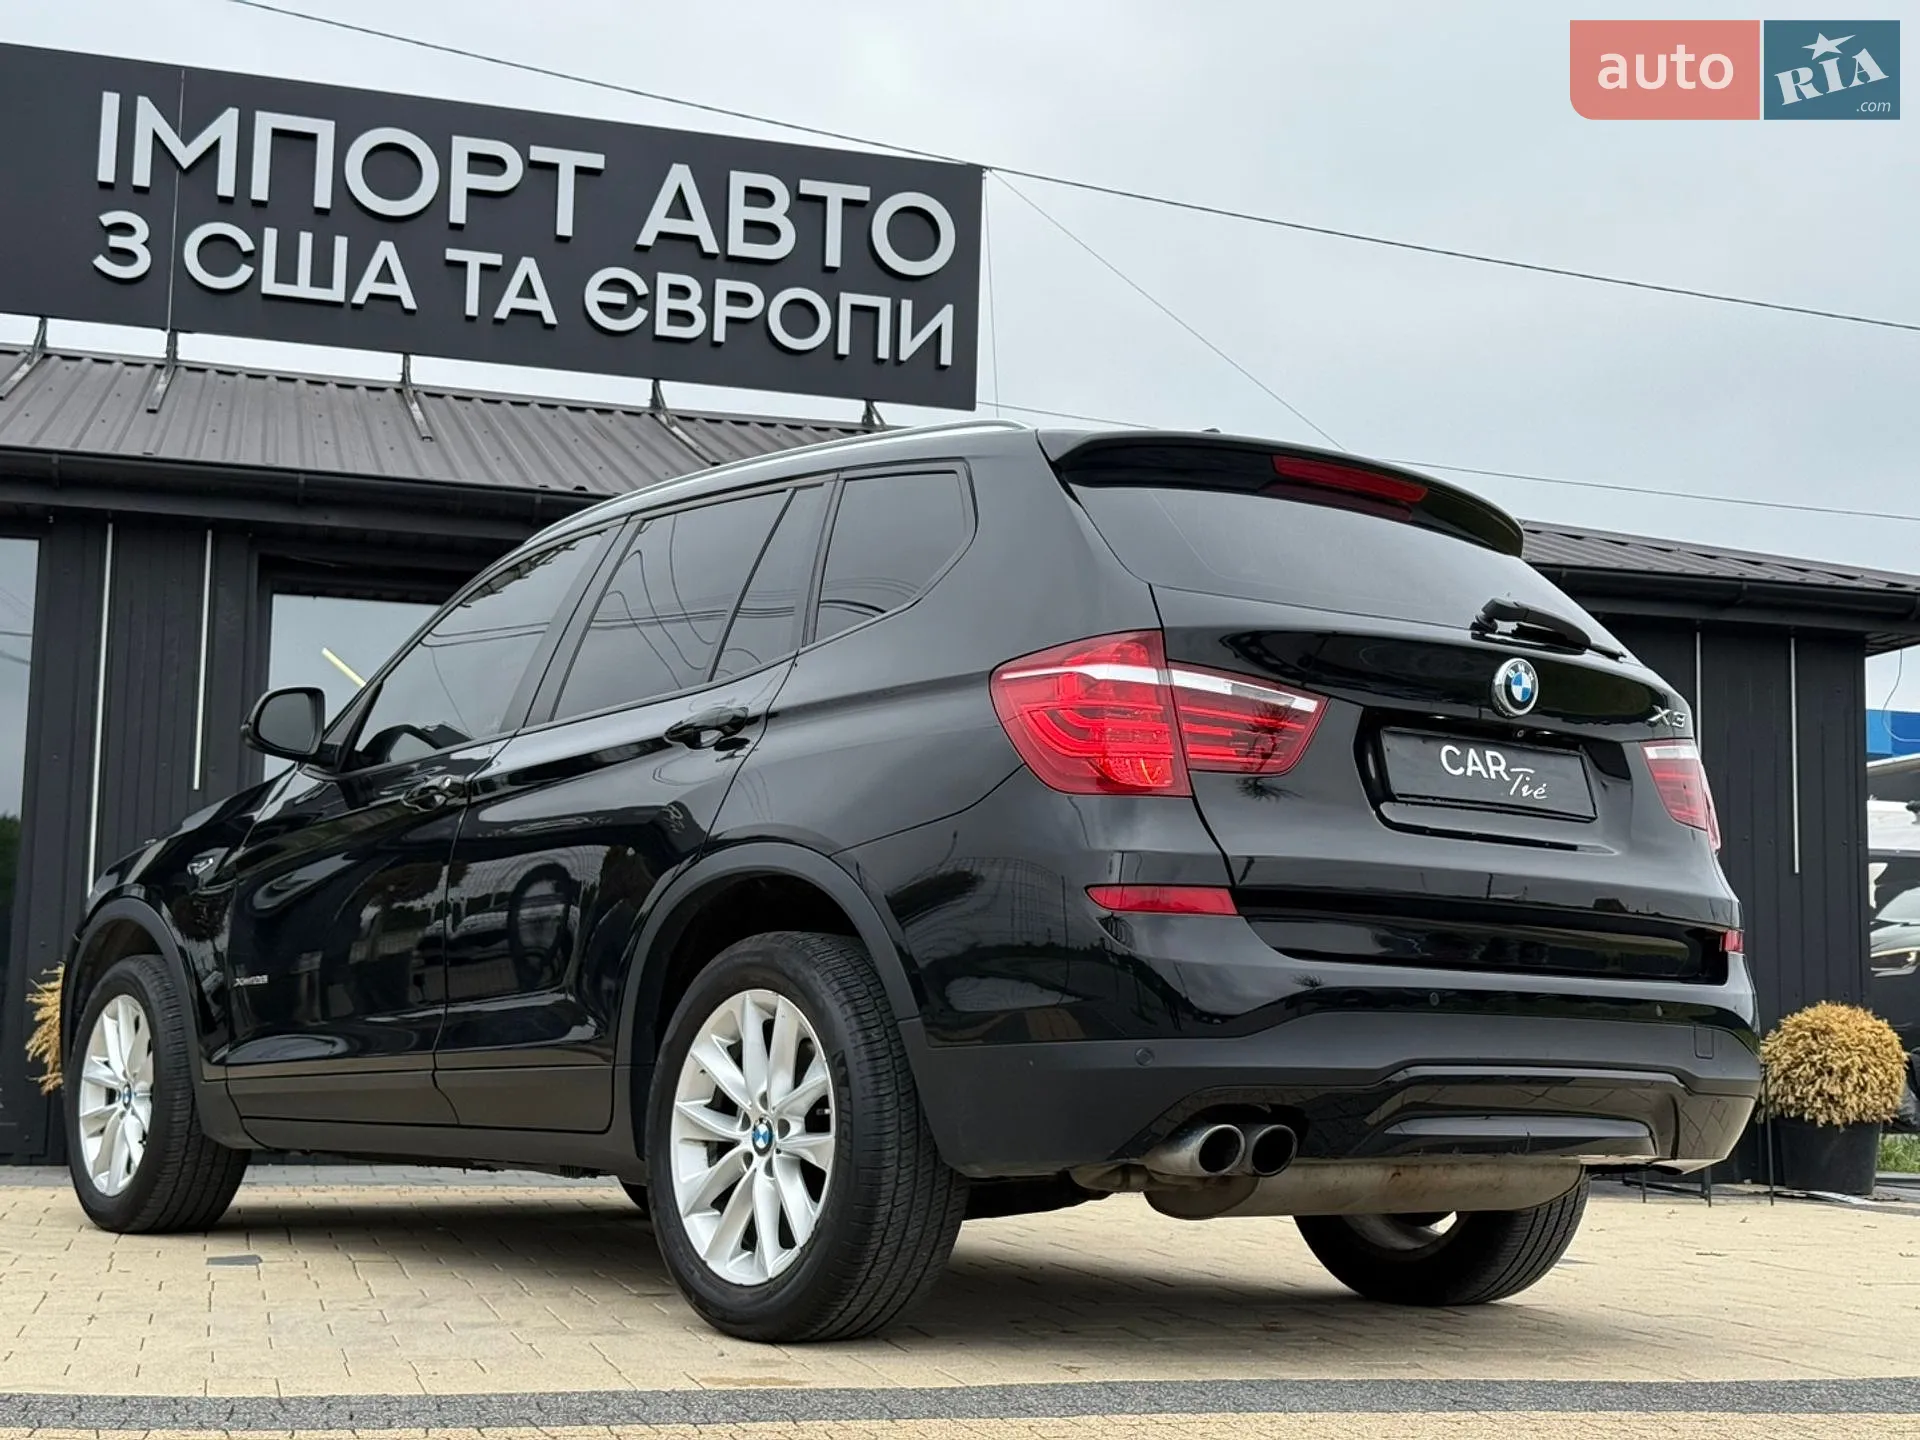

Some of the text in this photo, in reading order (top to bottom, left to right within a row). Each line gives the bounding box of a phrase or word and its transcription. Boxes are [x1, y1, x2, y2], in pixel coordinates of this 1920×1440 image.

[96, 90, 956, 276] ІМПОРТ АВТО
[92, 210, 954, 366] З США ТА ЄВРОПИ
[1440, 744, 1511, 781] CAR
[1647, 704, 1687, 728] X3
